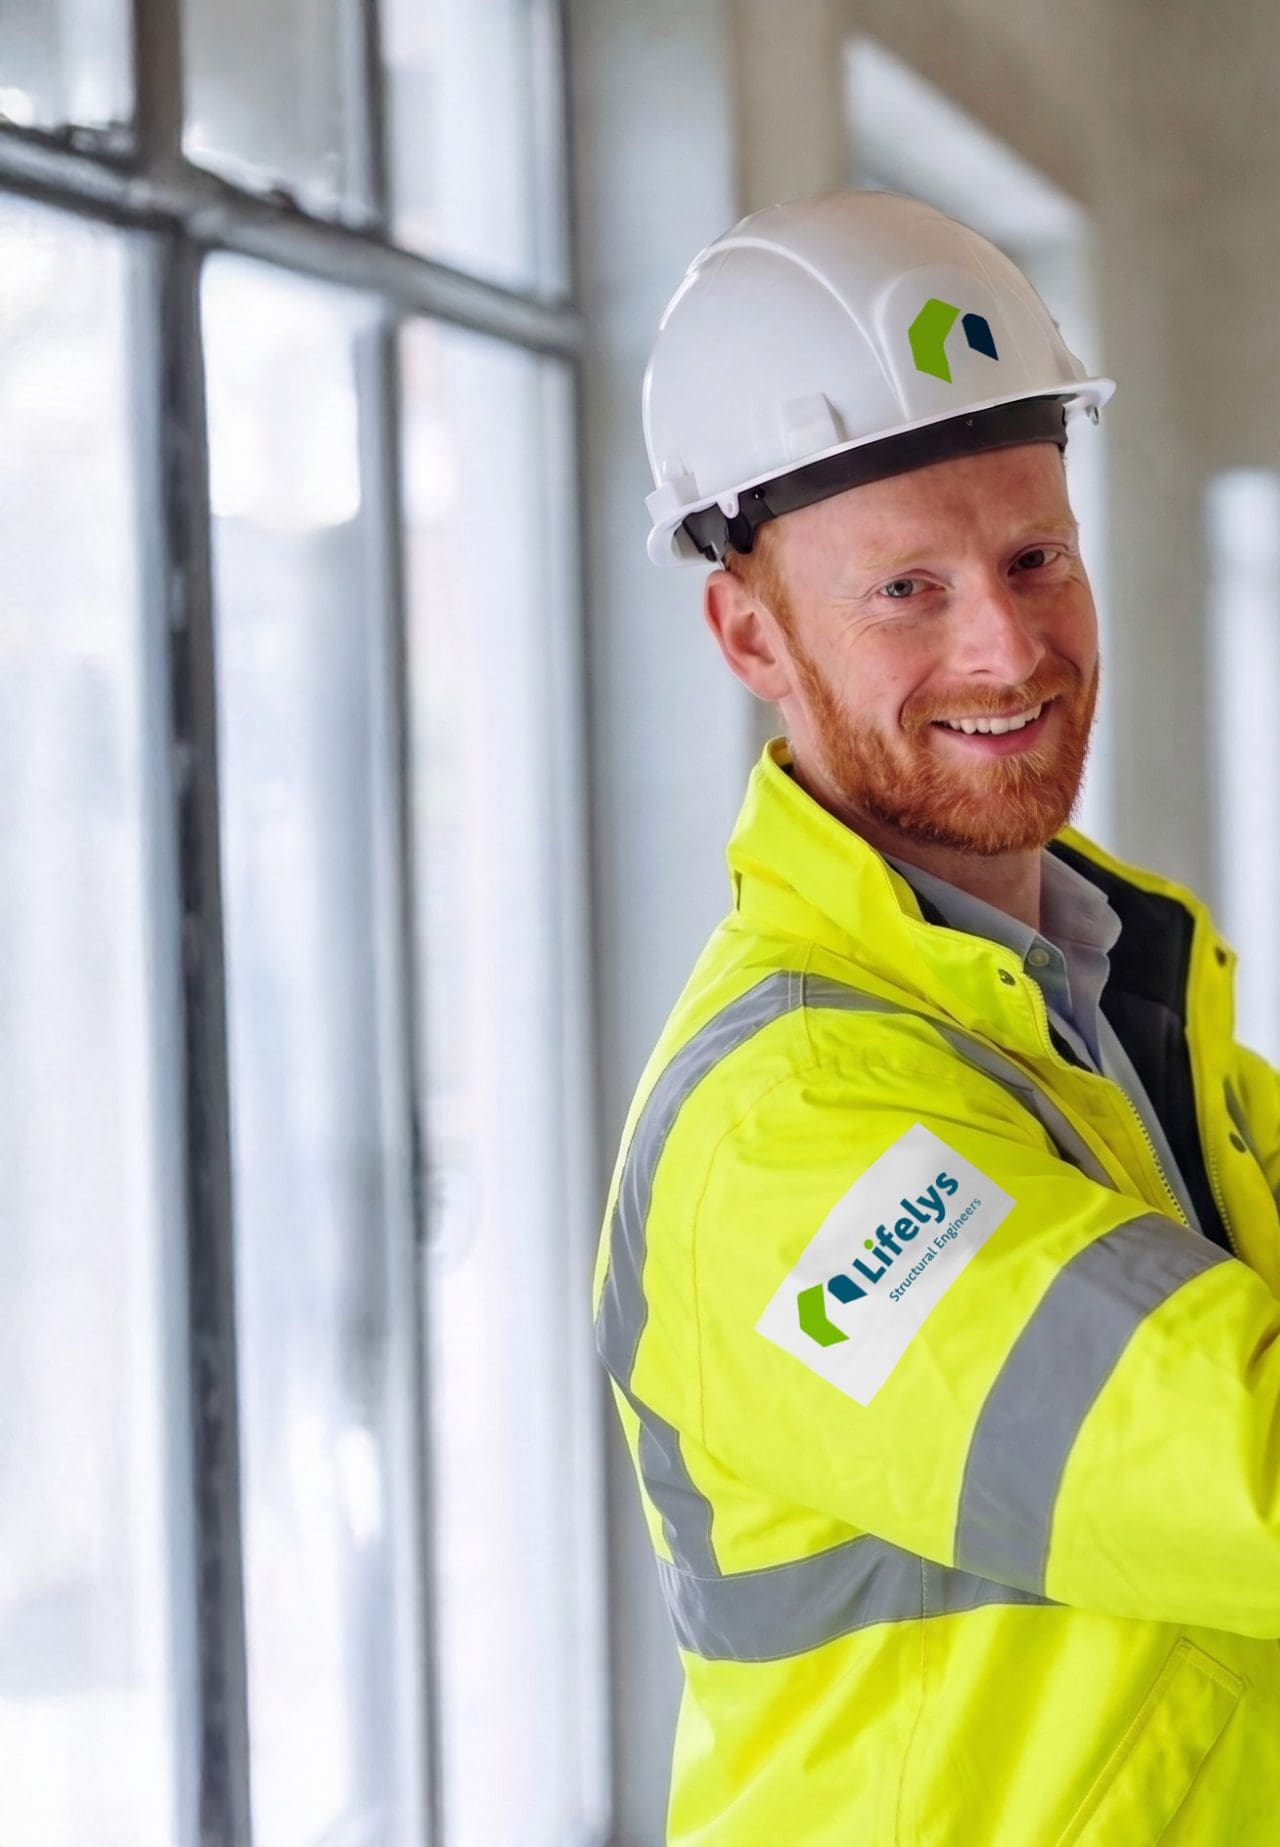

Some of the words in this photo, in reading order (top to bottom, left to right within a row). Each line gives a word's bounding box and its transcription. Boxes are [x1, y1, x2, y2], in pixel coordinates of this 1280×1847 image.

[852, 1172, 959, 1284] Lifelys
[889, 1247, 938, 1302] Structural
[933, 1197, 982, 1249] Engineers
